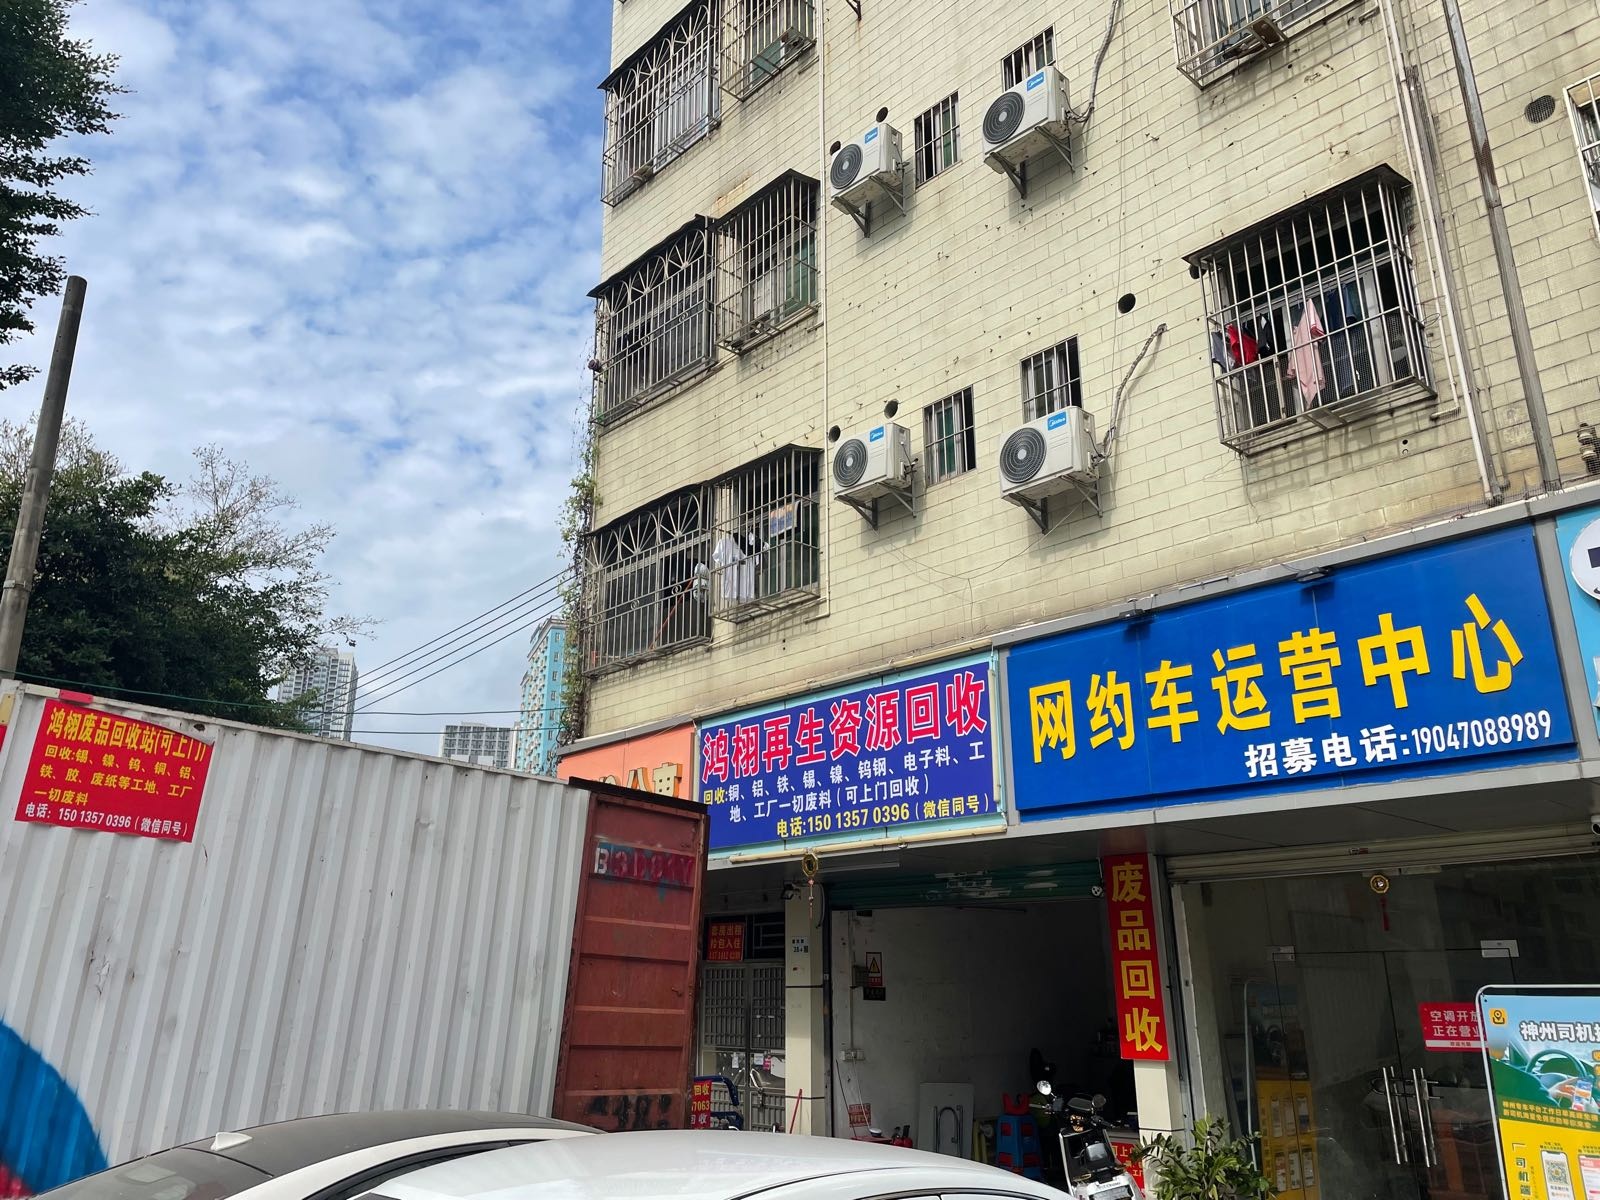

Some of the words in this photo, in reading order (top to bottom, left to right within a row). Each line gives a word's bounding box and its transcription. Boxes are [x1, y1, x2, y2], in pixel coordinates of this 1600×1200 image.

[701, 670, 988, 784] 鸿栩再生资源回收
[1029, 593, 1524, 763] 网约车运营中心
[34, 788, 89, 805] 一切废料
[1112, 861, 1163, 1053] 废品回收
